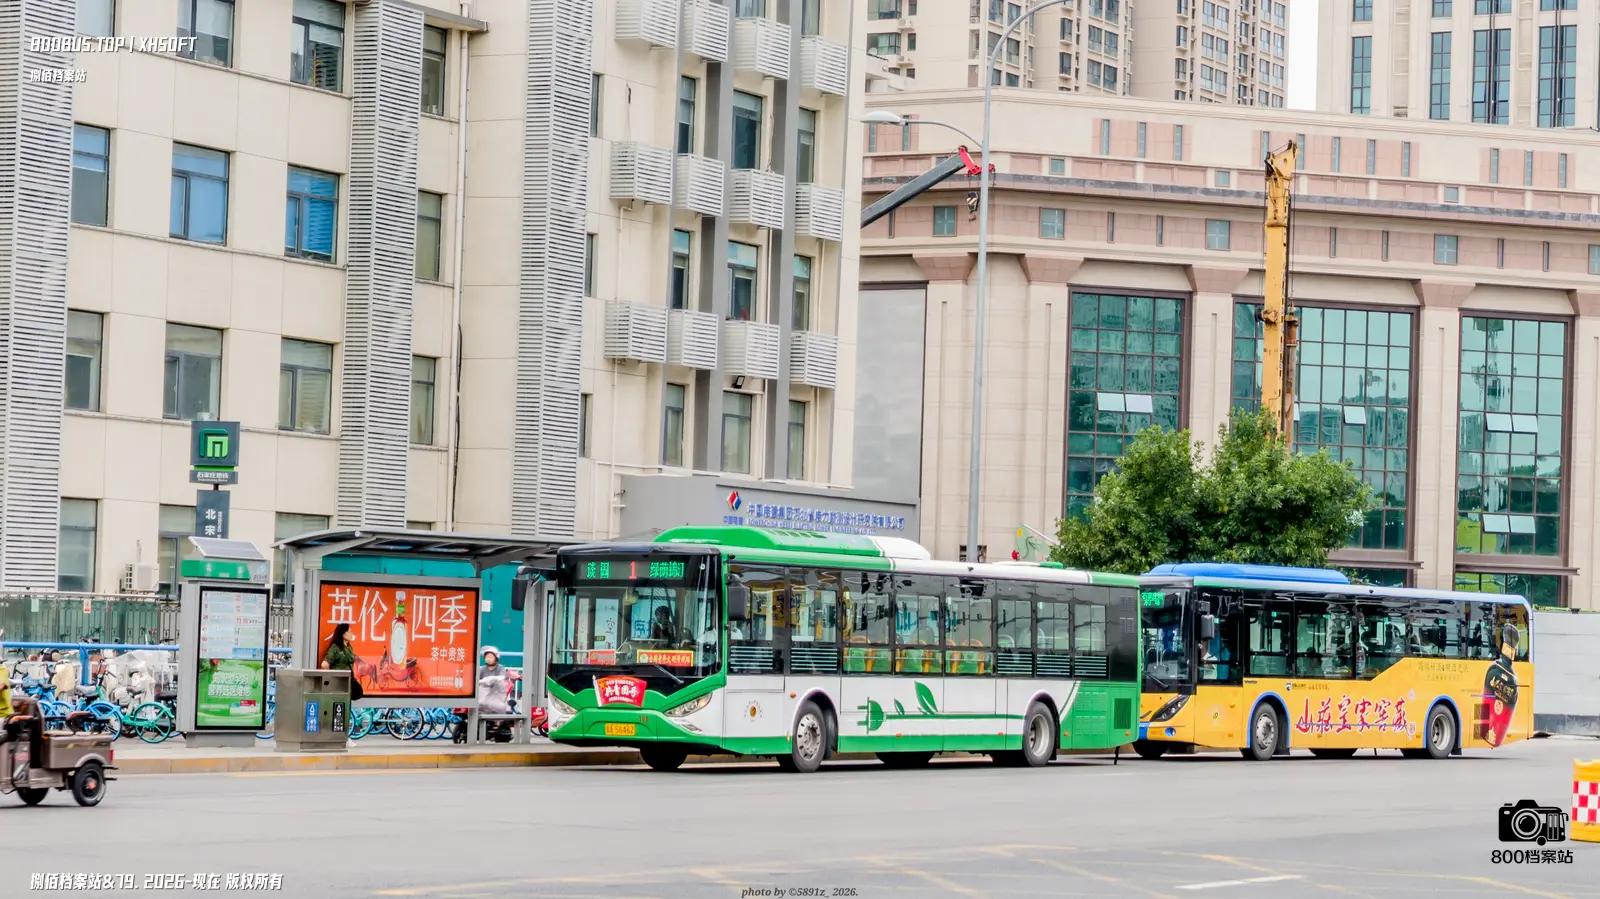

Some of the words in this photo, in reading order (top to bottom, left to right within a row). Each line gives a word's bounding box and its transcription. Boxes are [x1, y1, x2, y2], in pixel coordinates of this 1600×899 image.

[205, 509, 216, 535] 北宋
[629, 561, 637, 579] 1
[325, 588, 388, 642] 英伦
[412, 594, 467, 645] 四季
[431, 646, 465, 661] 茶中贵族
[605, 685, 638, 698] 共青团号
